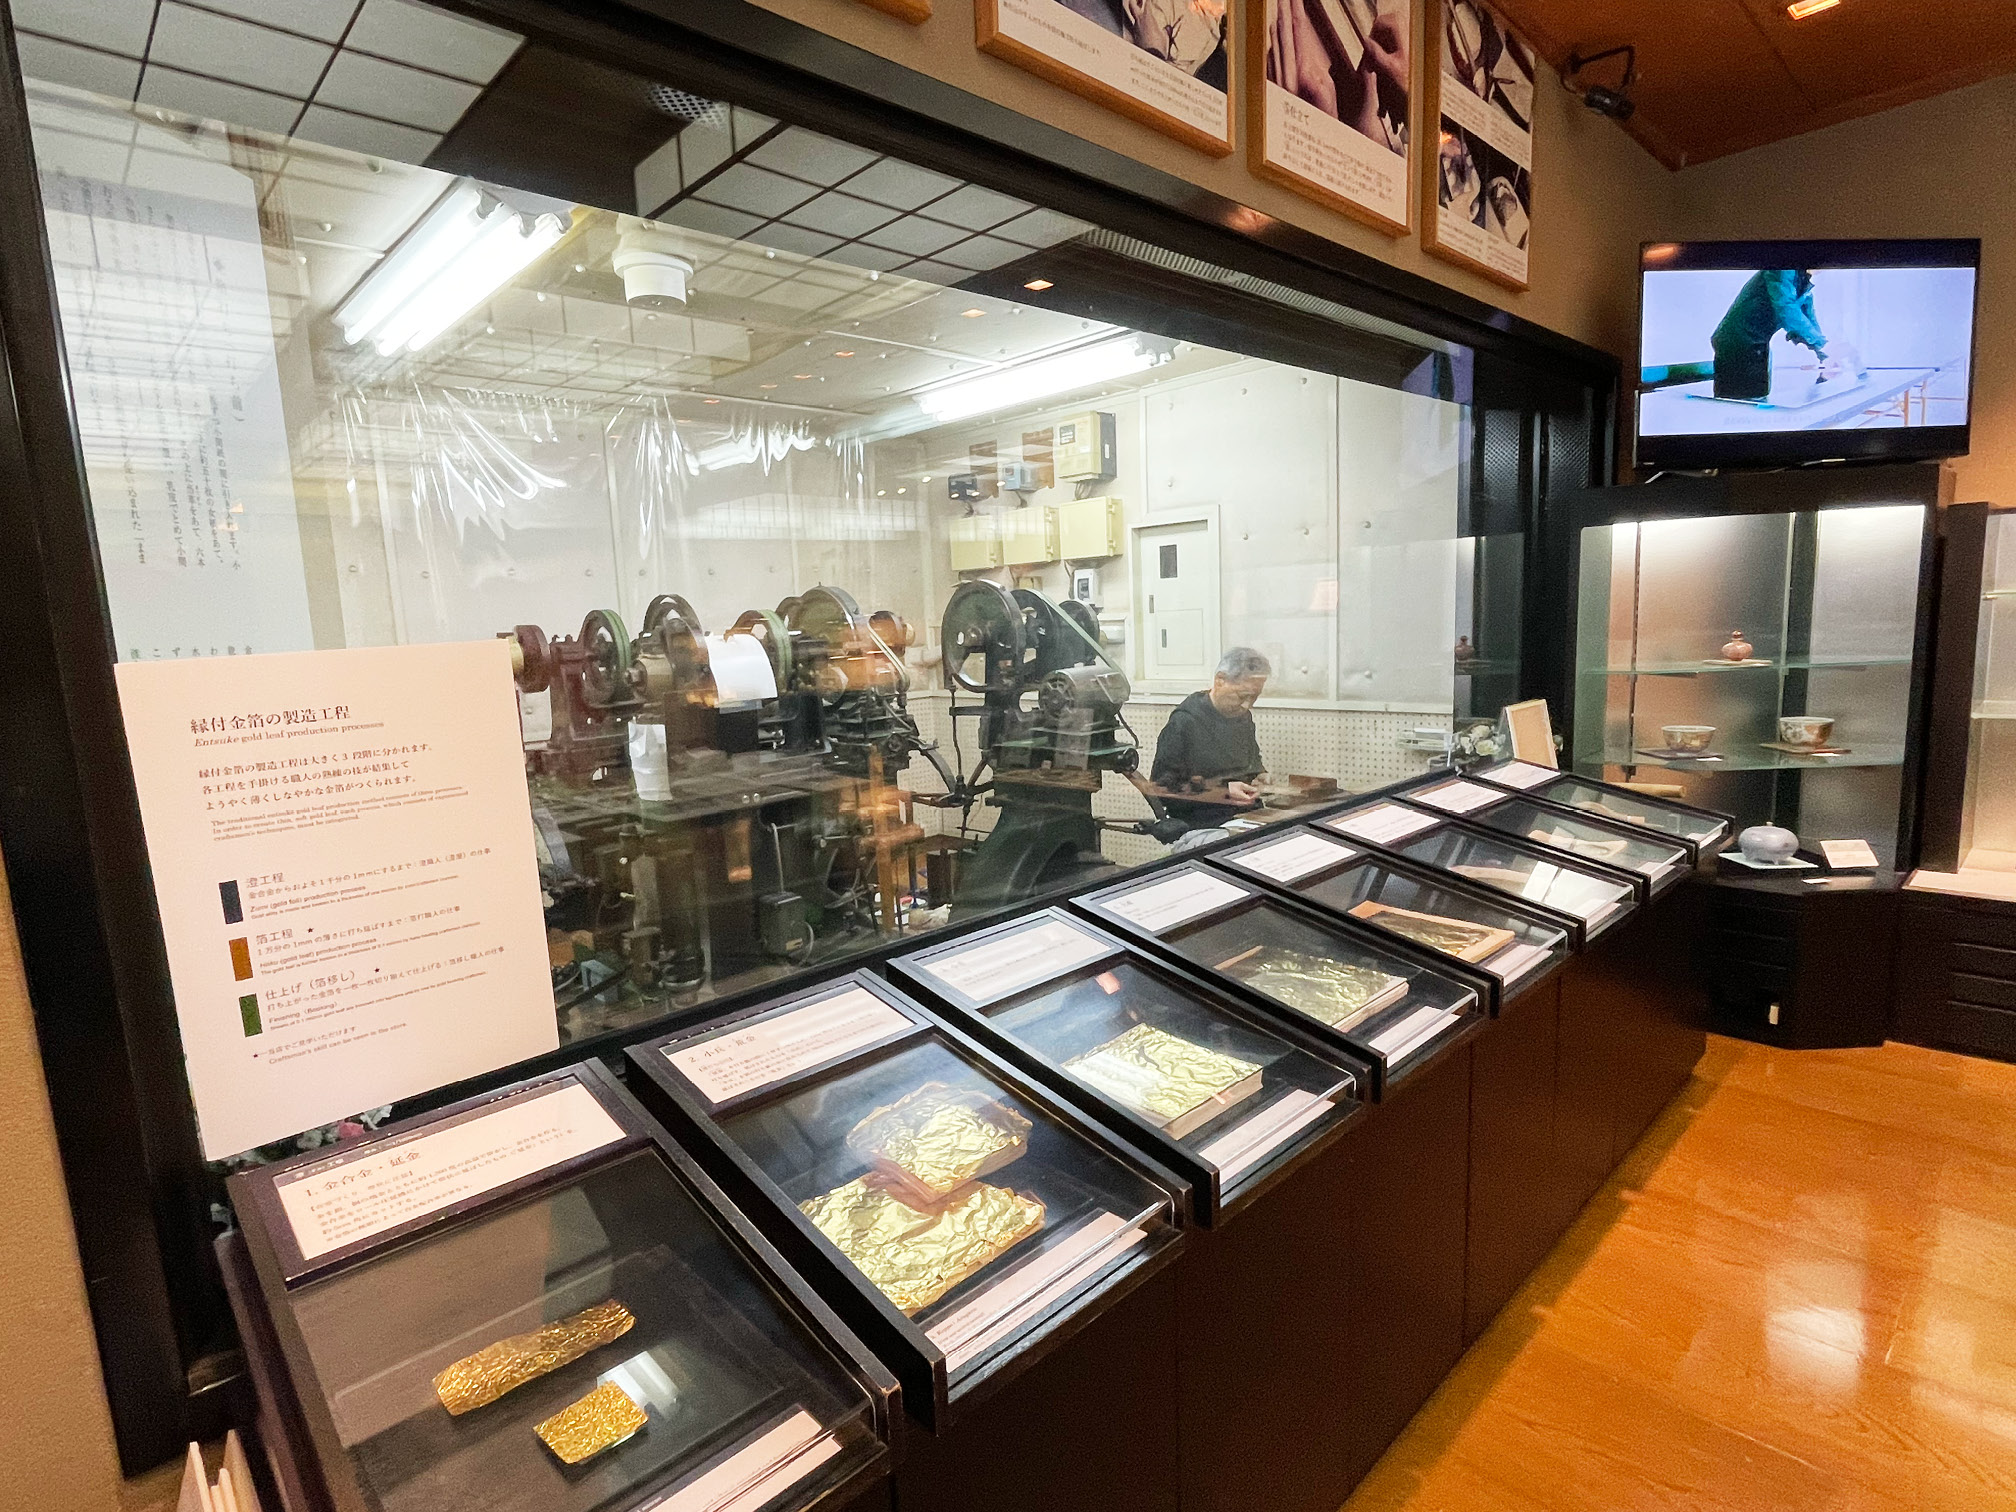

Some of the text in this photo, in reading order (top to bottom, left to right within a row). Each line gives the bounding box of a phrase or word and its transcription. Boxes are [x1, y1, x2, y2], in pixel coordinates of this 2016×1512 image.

[190, 705, 351, 734] 縁付金箔の製造工程
[194, 736, 240, 747] Entsuke
[241, 732, 262, 743] gold
[265, 730, 284, 739] leaf
[287, 724, 338, 738] production
